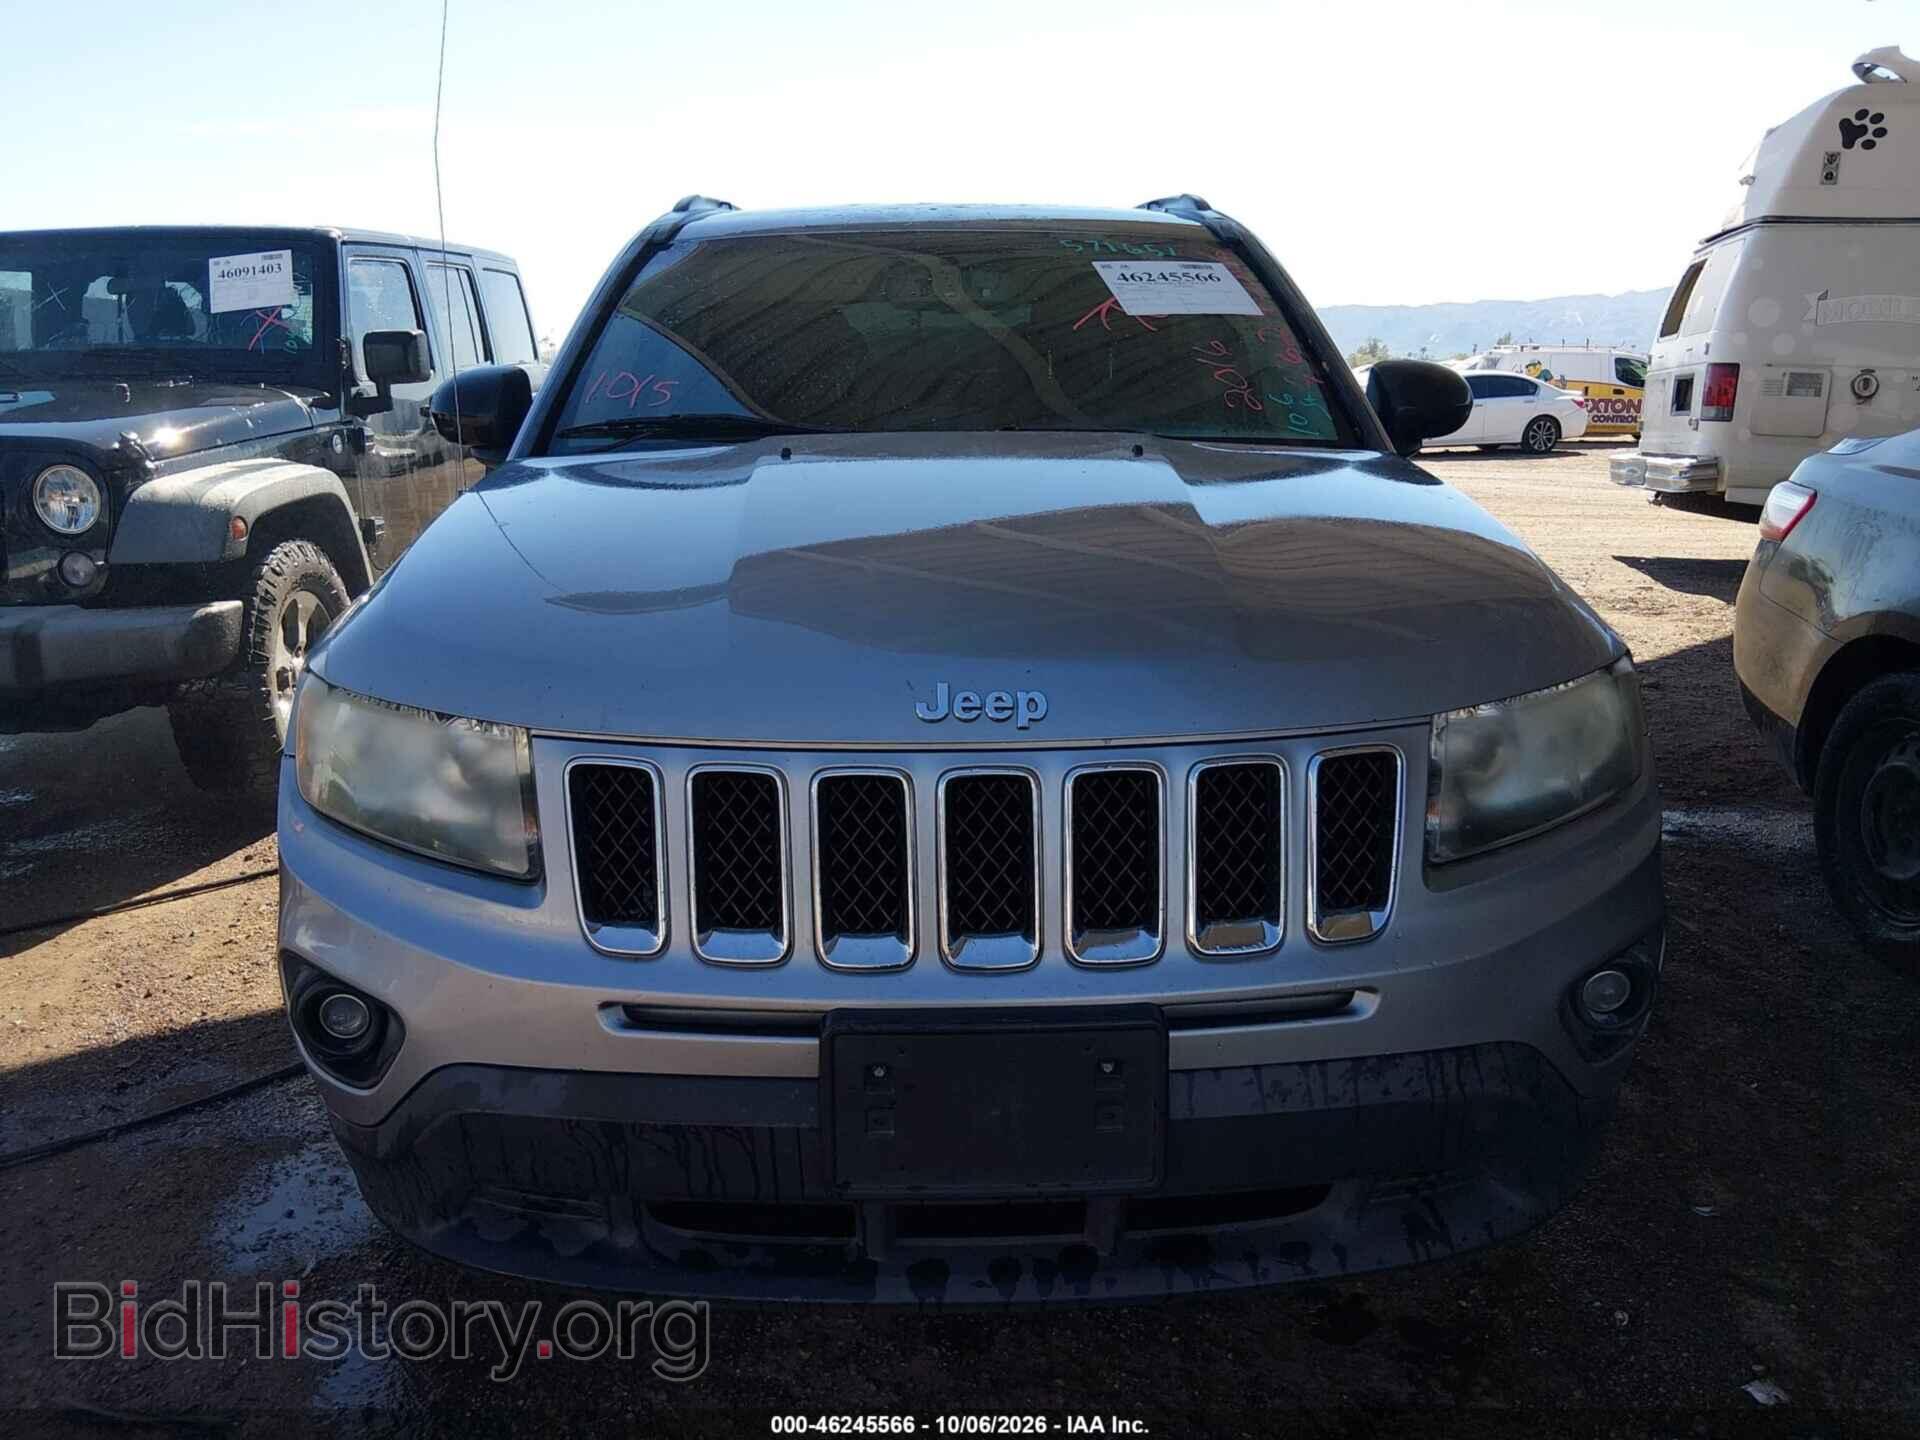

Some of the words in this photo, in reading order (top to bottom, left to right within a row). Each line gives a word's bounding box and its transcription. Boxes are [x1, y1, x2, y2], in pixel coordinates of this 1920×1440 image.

[217, 263, 282, 279] 46091403
[1116, 271, 1221, 283] 46245566
[914, 681, 1048, 729] Jeep
